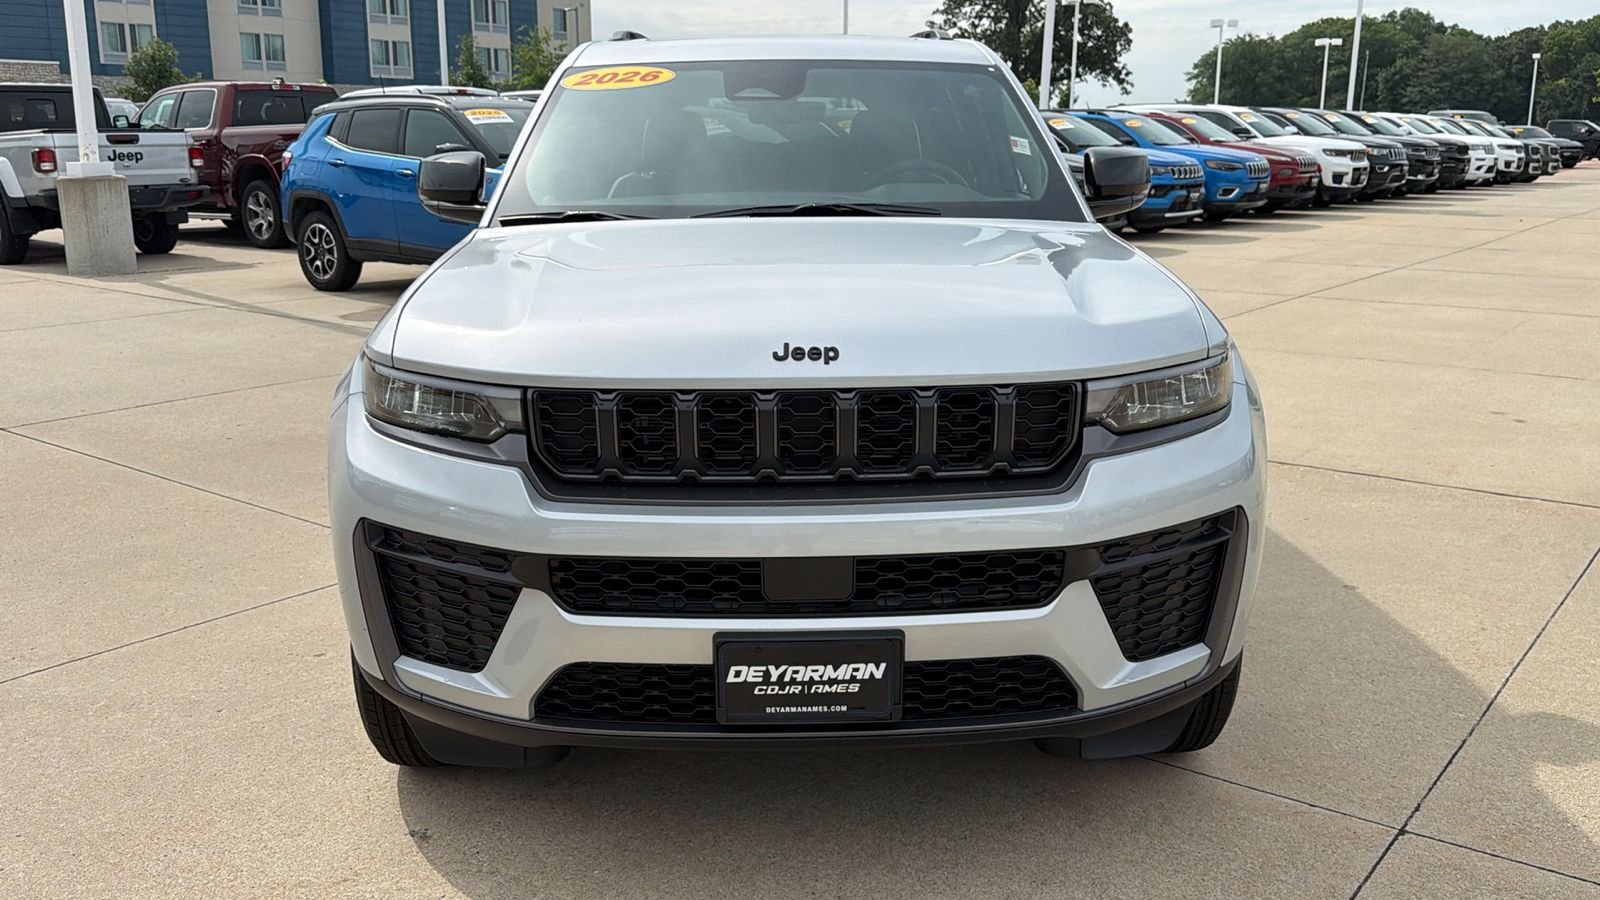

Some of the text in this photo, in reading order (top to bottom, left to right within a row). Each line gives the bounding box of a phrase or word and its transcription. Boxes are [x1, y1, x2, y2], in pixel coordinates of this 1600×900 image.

[572, 71, 663, 86] 2026
[107, 149, 144, 164] Jeep
[772, 342, 840, 365] Jeep
[726, 662, 887, 683] DEYARMAN
[810, 683, 861, 694] AMES
[766, 705, 847, 713] DEYARMANAMES.COM
